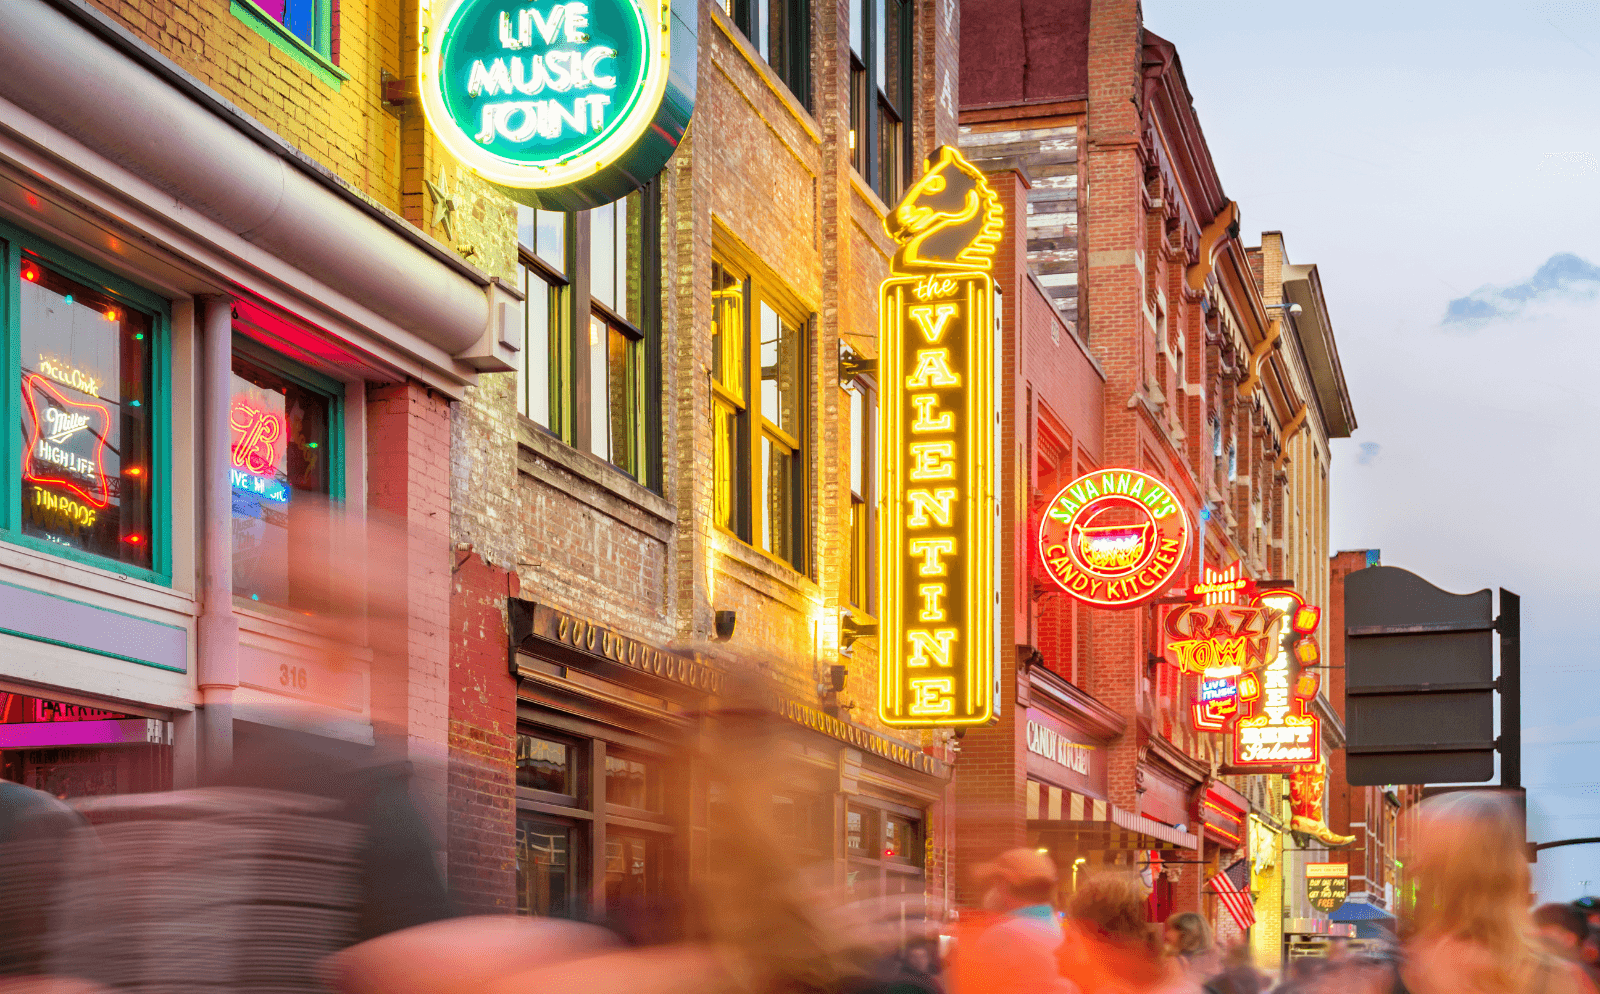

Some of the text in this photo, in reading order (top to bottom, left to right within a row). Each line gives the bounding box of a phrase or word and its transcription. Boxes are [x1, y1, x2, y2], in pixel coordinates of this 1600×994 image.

[499, 2, 589, 50] LIVE
[466, 45, 617, 98] MUSIC
[474, 94, 611, 145] JOINT
[913, 274, 958, 301] the
[47, 407, 90, 435] Miller
[39, 439, 95, 479] HIGH LIFE
[231, 468, 248, 489] IVE
[34, 486, 96, 527] TIN ROOF
[906, 303, 962, 716] VALENTINE
[1049, 473, 1178, 525] SAVANNAH'S
[1047, 538, 1179, 599] CANDY KITCHEN
[1194, 578, 1247, 594] Welcome to
[1164, 602, 1285, 640] CRAZY
[1297, 610, 1317, 630] WB
[1167, 636, 1269, 674] TOWN
[280, 664, 307, 689] 316
[1203, 679, 1227, 690] LIVE
[1203, 686, 1237, 700] MUSIC
[1238, 678, 1257, 698] WB
[1027, 719, 1091, 776] CANDY KITCHEN
[1241, 742, 1313, 761] Saloon
[1317, 898, 1334, 907] FREE
